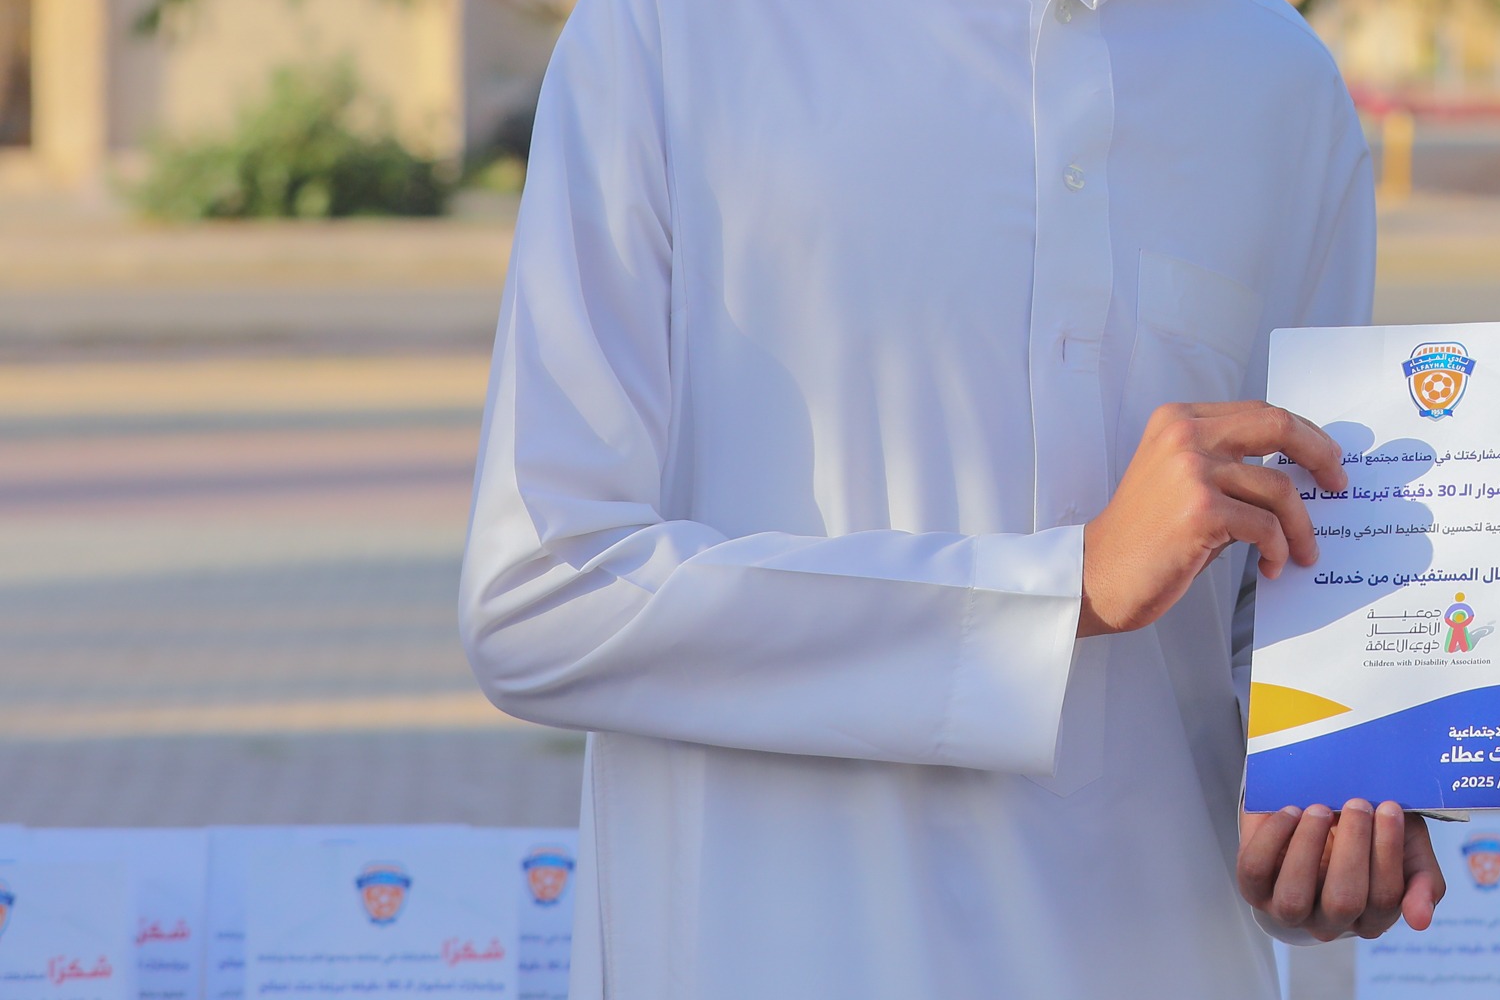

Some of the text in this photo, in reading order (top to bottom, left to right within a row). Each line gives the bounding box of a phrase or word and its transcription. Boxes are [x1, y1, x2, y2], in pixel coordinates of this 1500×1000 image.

[1411, 362, 1466, 374] ALFAYHA CLUB
[1341, 450, 1363, 466] أكثر
[1365, 453, 1399, 466] مجتمع
[1401, 451, 1432, 462] صناعة
[1434, 450, 1451, 467] في
[1352, 485, 1390, 502] تبرعنا
[1392, 483, 1434, 502] دقيقة
[1437, 483, 1457, 497] 30
[1353, 524, 1392, 540] الحركي
[1395, 522, 1440, 537] التخطيط
[1441, 521, 1483, 536] لتحسين
[1313, 570, 1364, 586] خدمات
[1367, 573, 1389, 587] من
[1392, 567, 1479, 587] المستفيدين
[1366, 608, 1442, 622] جمعية
[1363, 657, 1491, 668] Children with Disability Association
[1440, 745, 1485, 764] عطاء
